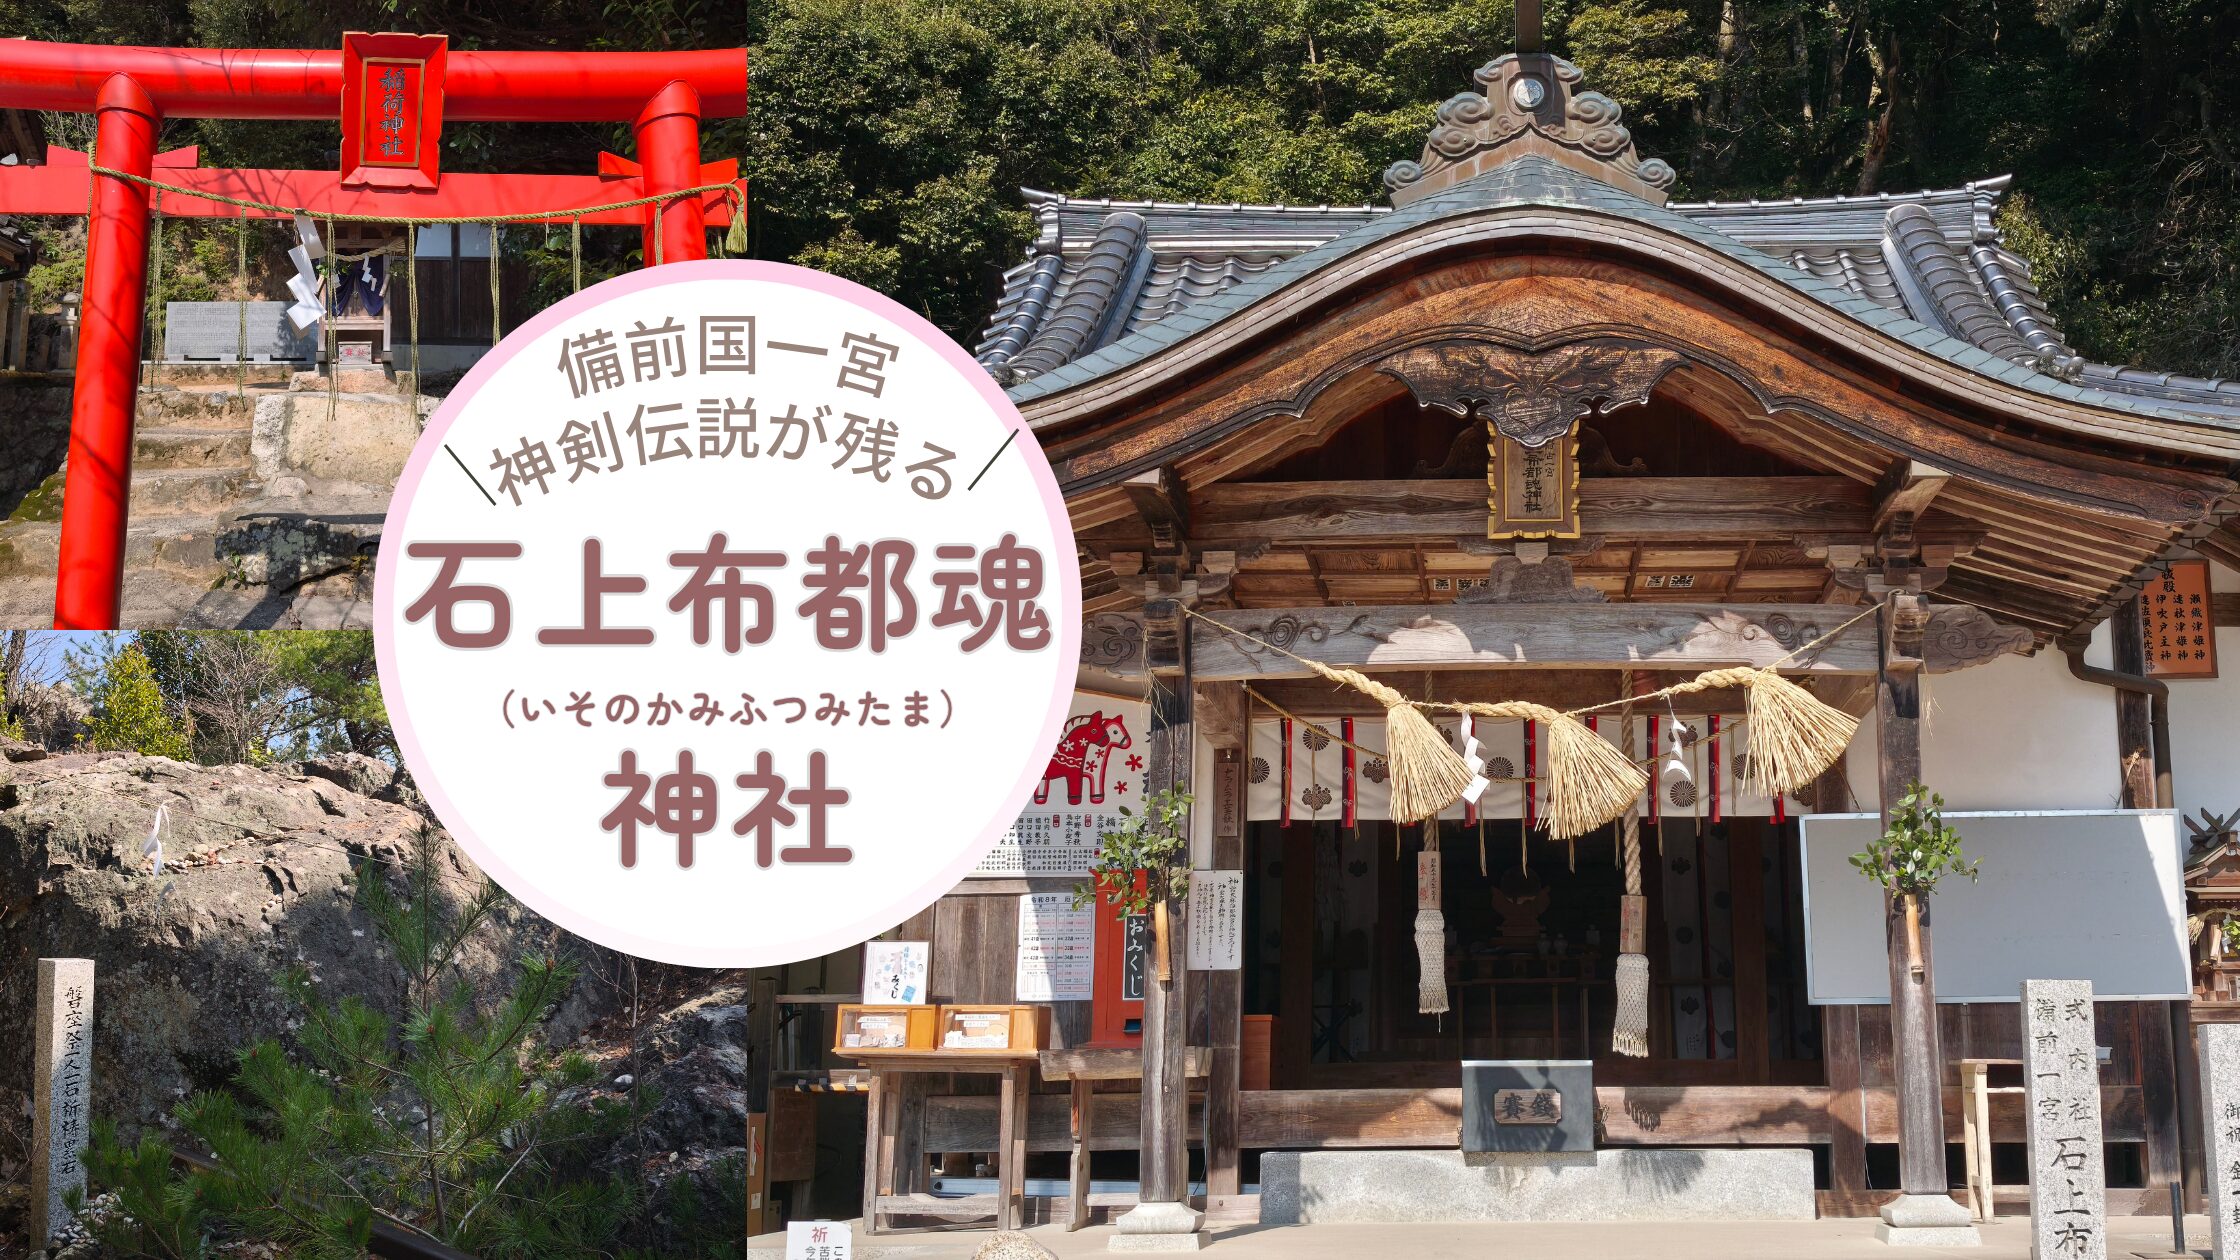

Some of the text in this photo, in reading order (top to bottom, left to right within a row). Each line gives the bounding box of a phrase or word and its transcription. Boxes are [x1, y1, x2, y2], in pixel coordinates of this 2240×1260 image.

[1127, 918, 1145, 996] おみくじ
[2034, 998, 2061, 1122] 備前一宮
[2064, 998, 2093, 1121] 式内社
[811, 1226, 828, 1244] 祈
[2050, 1135, 2093, 1260] 石上布
